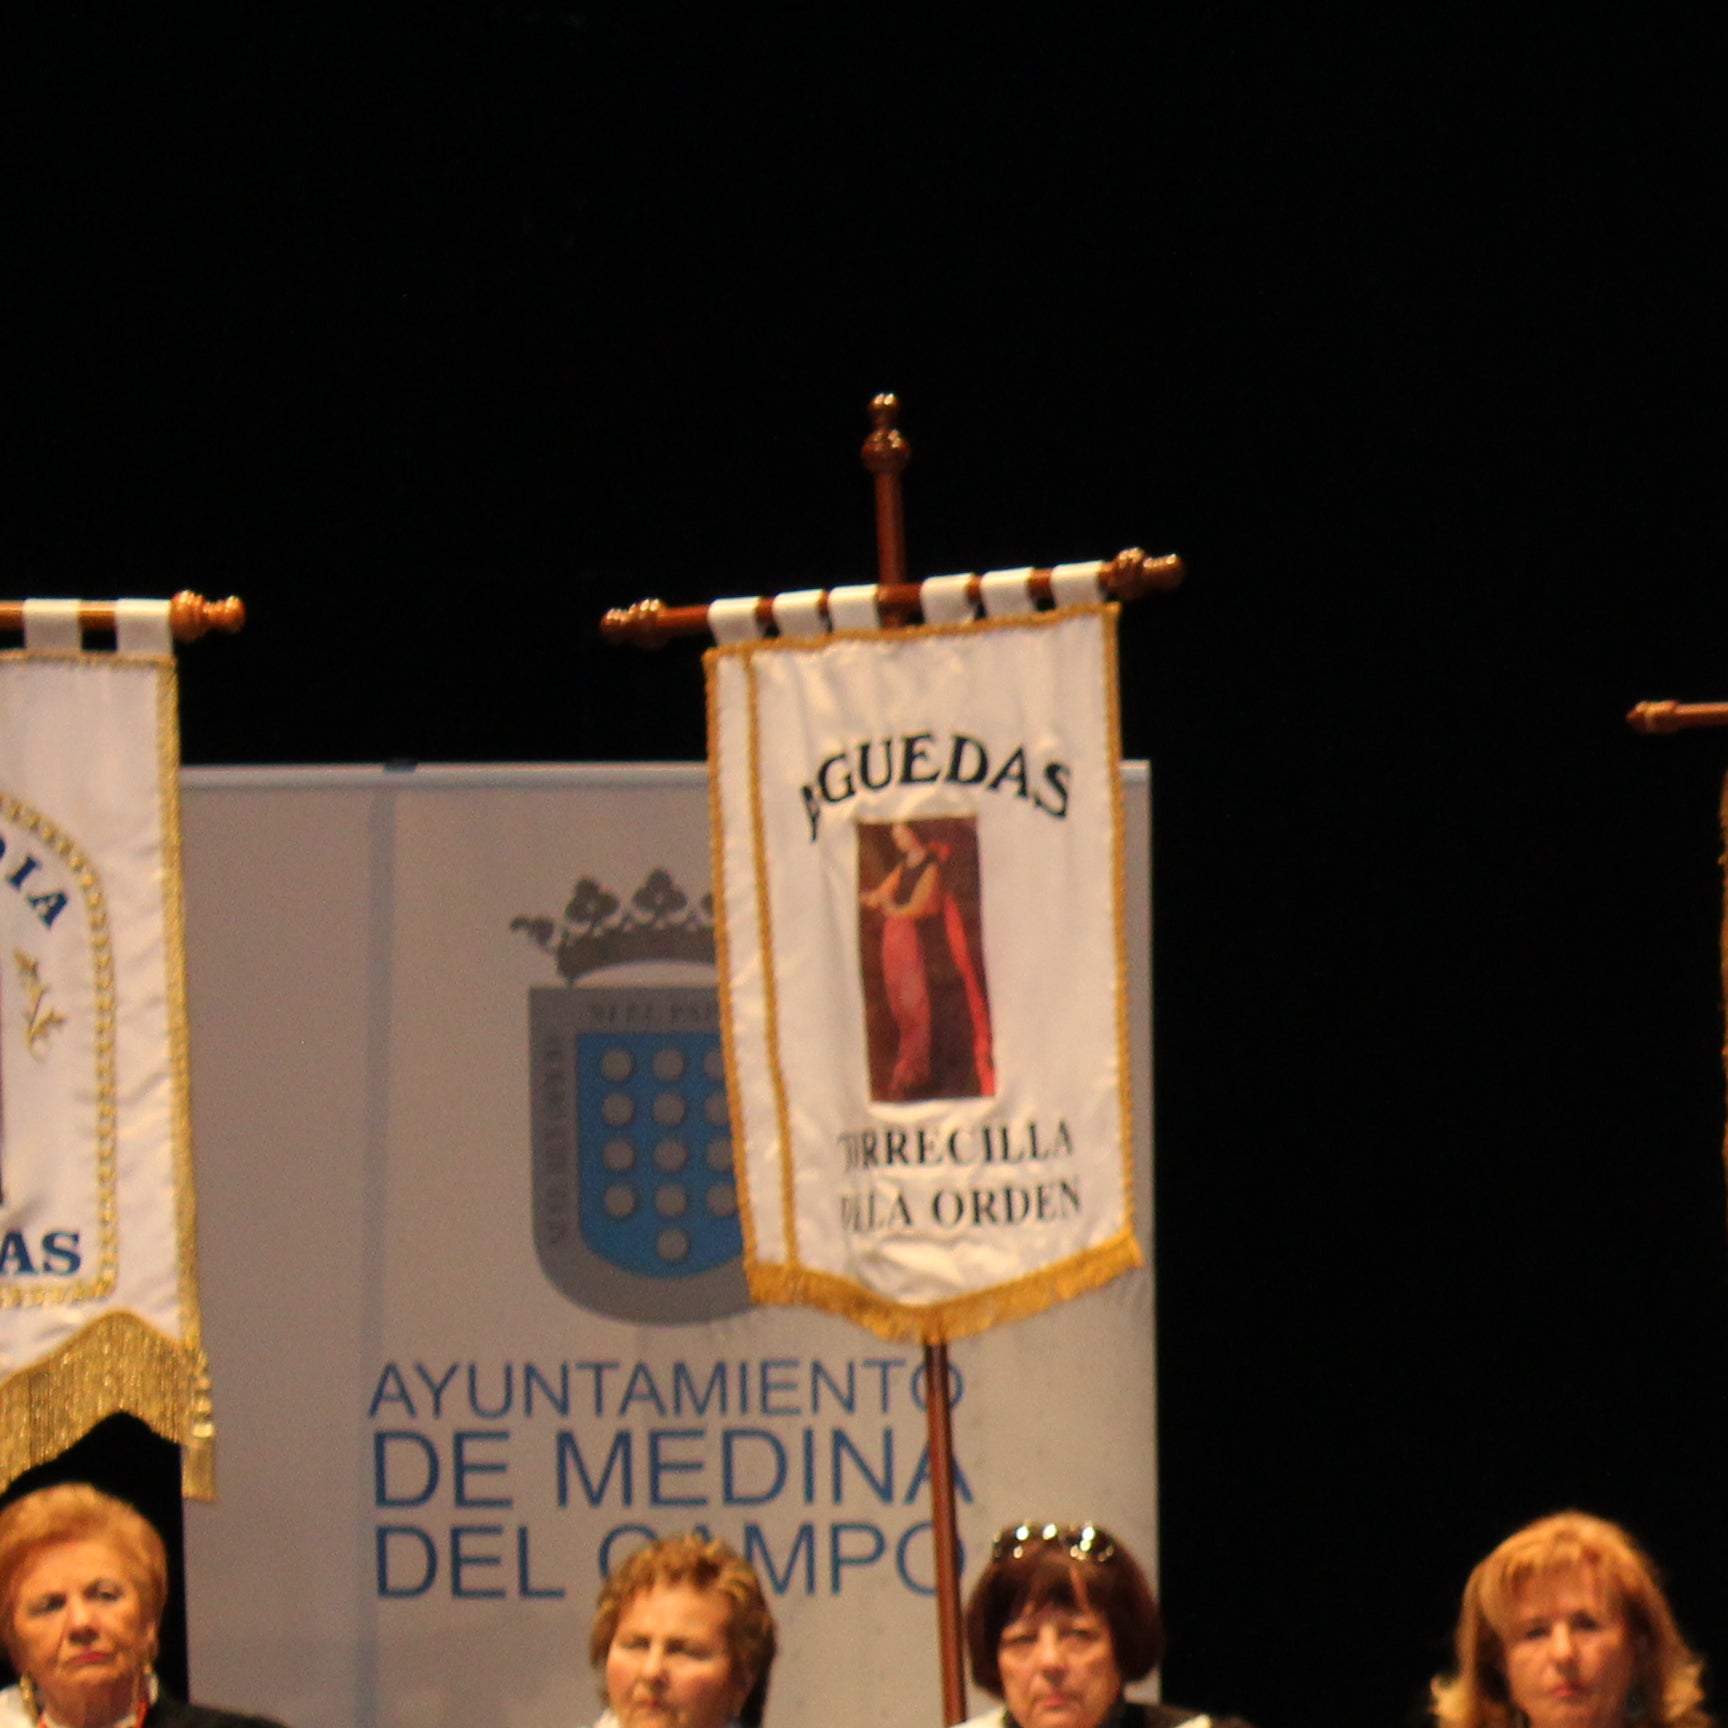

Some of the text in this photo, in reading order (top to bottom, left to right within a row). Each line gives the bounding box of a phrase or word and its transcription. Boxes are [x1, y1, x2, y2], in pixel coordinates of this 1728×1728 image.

[932, 1174, 1081, 1227] ORDEN
[367, 1358, 964, 1419] AYUNTAMIENTO
[373, 1427, 974, 1510] DE MEDINA
[375, 1521, 964, 1598] DEL CMPO
